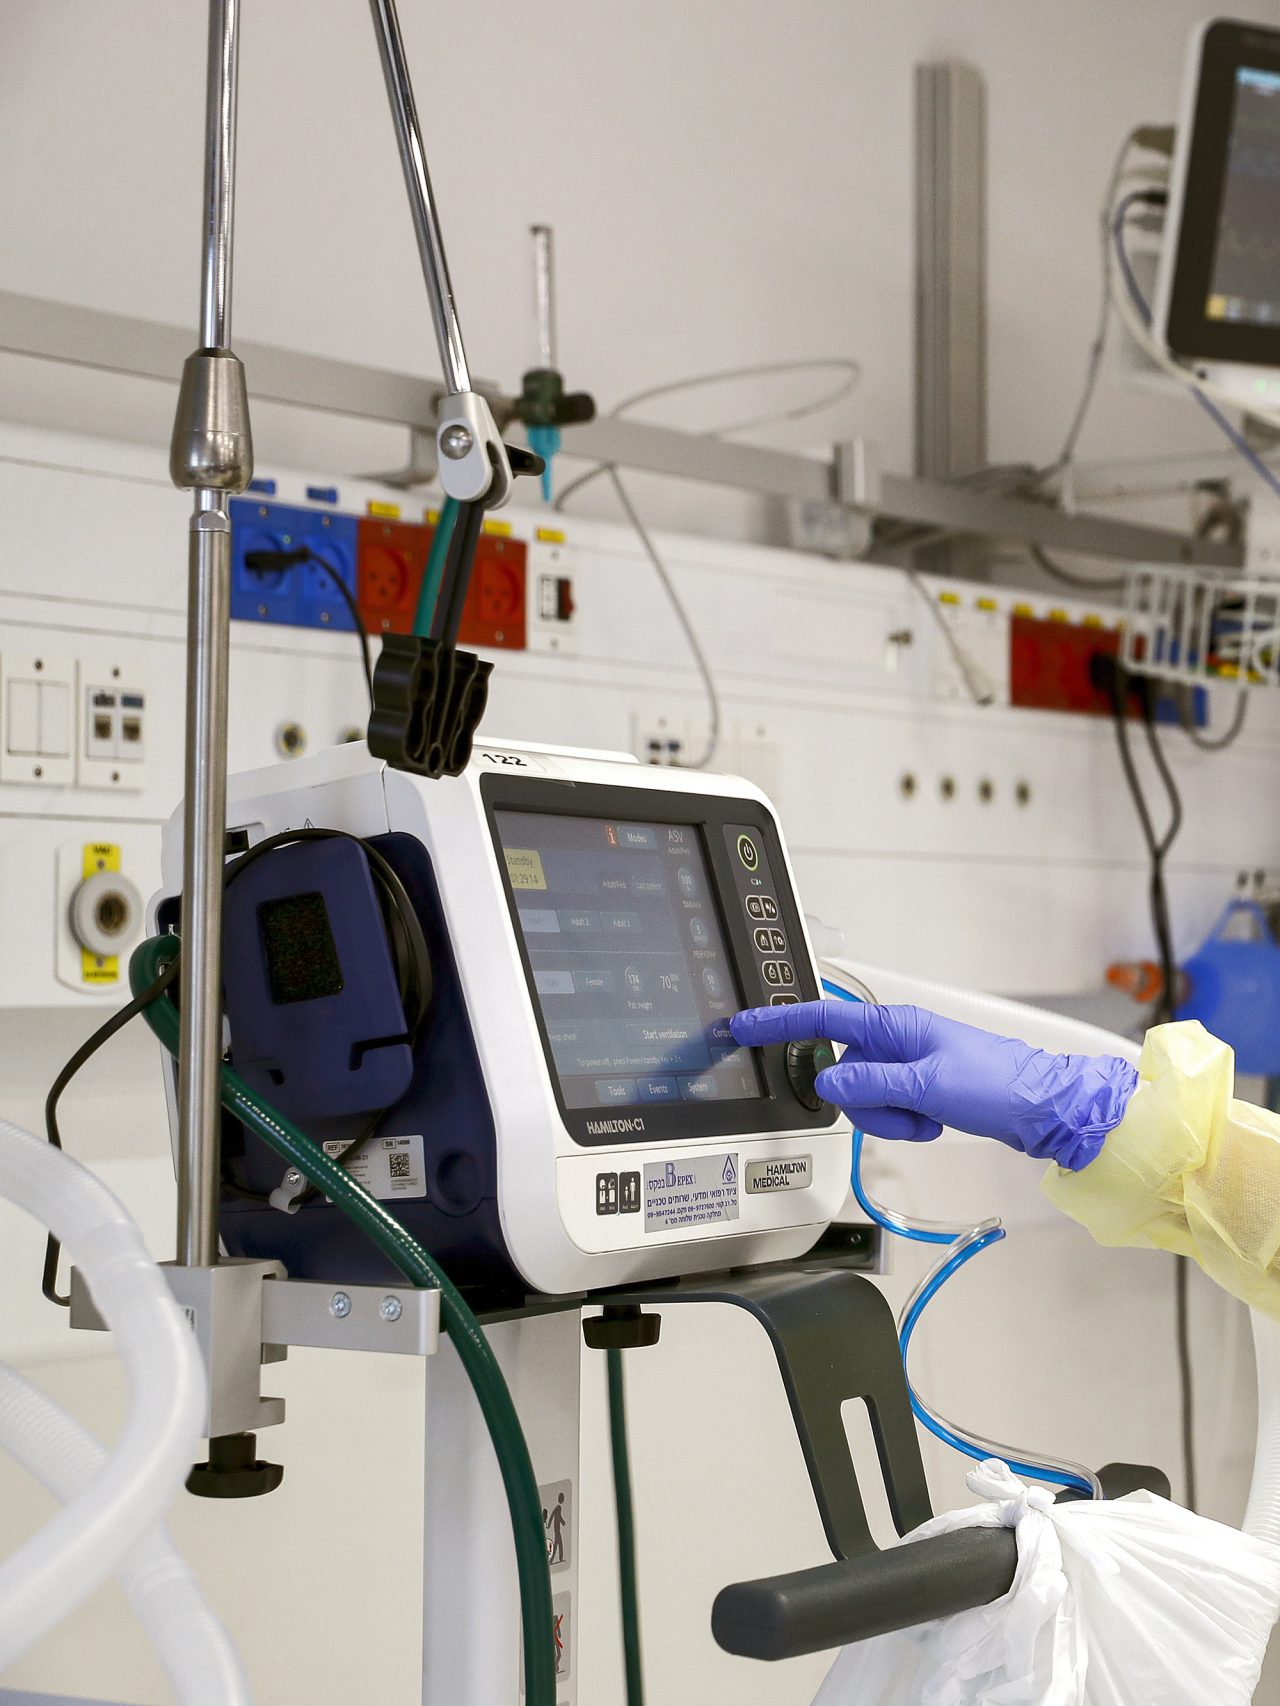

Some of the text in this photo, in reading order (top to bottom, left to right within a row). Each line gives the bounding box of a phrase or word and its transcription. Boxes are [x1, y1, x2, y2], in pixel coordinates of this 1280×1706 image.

[482, 754, 527, 766] 122
[626, 832, 647, 843] Modes
[668, 830, 683, 842] ASV
[628, 974, 640, 984] 174
[660, 976, 671, 989] 70
[643, 1029, 688, 1040] Start ventilation
[608, 1086, 626, 1096] Tools
[649, 1084, 668, 1094] Events
[688, 1082, 708, 1092] System
[766, 1162, 806, 1176] HAMILTON
[753, 1175, 790, 1188] MEDICAL
[710, 1190, 724, 1198] רפואי
[726, 1187, 736, 1196] ציוד
[648, 1197, 666, 1207] טכניים
[691, 1192, 708, 1202] ומדעי,
